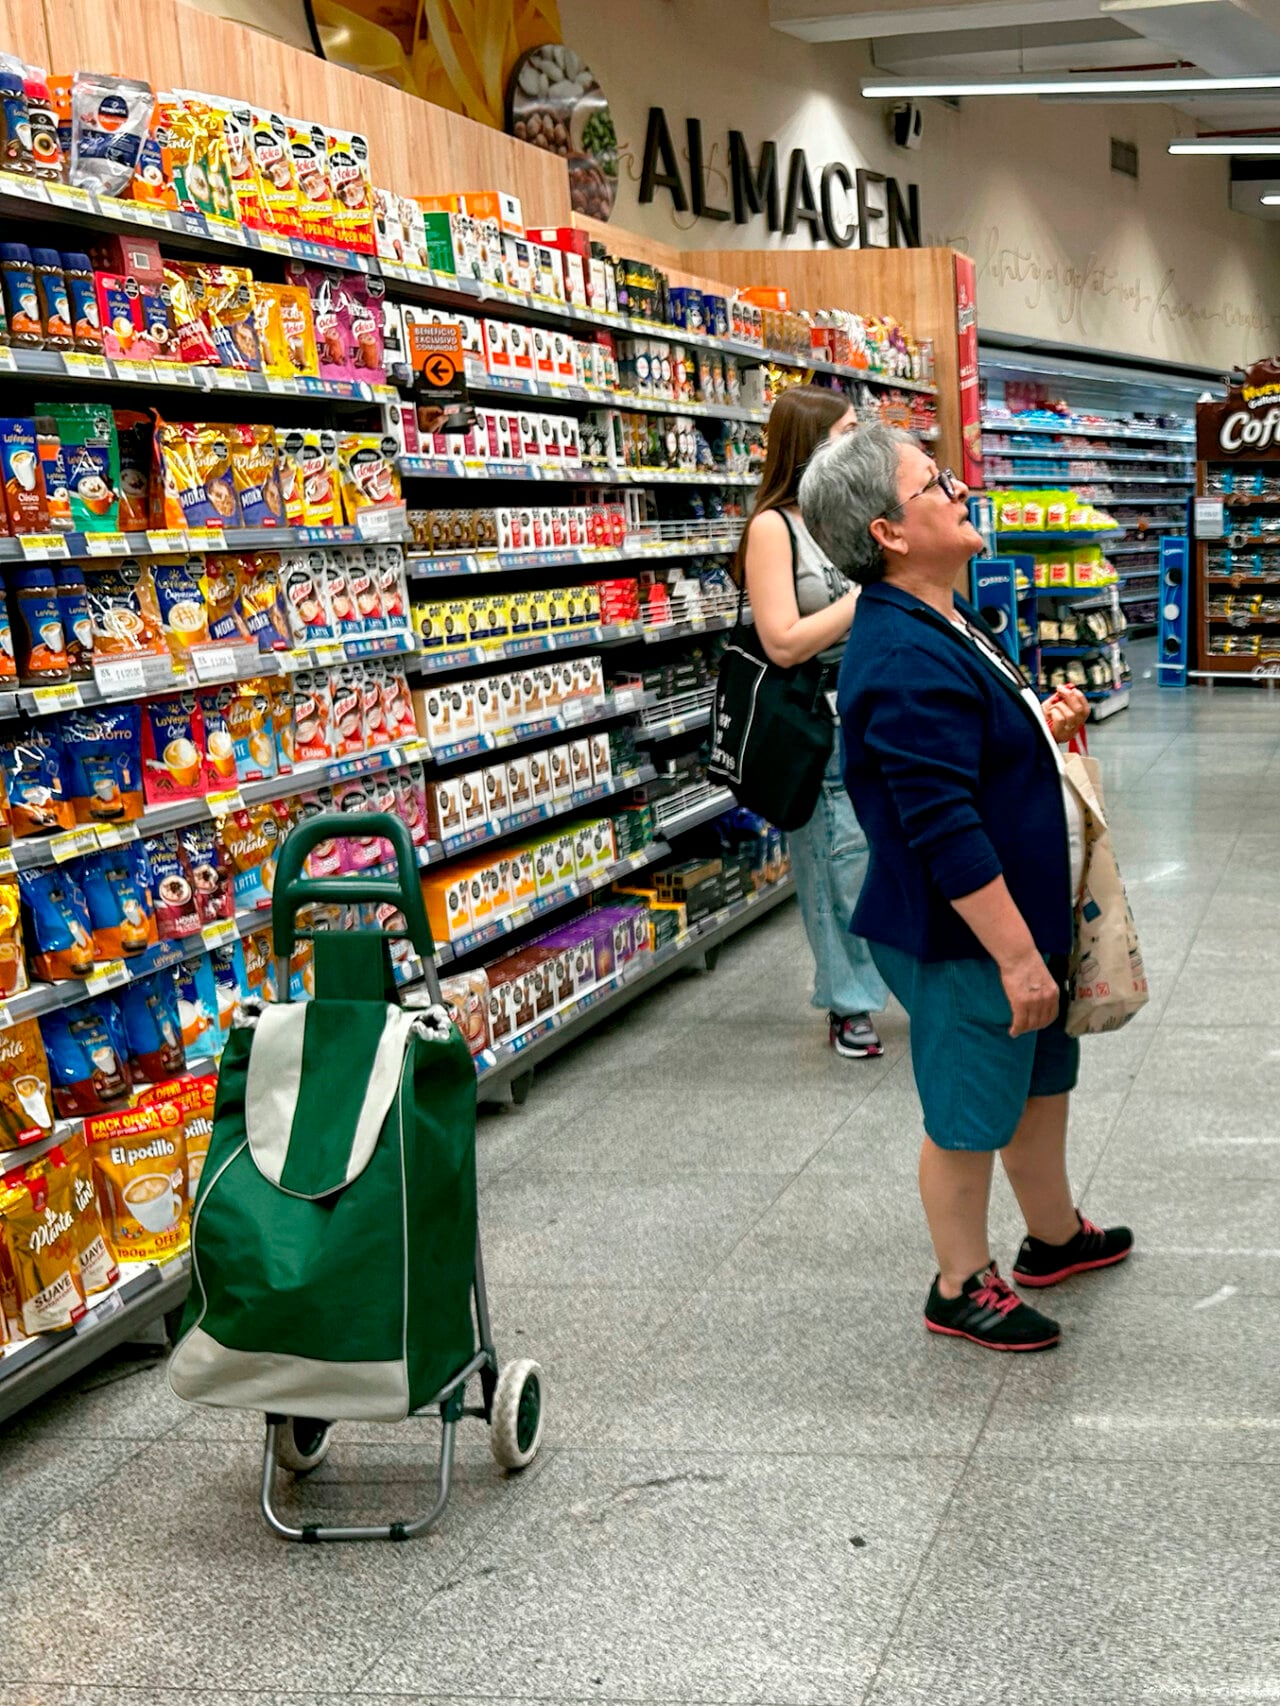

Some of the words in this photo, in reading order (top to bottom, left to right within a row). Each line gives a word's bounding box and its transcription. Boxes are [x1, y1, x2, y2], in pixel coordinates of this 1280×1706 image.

[638, 107, 921, 249] ALMACEN
[414, 328, 457, 337] BENEFICIO
[415, 336, 457, 345] EXCLUSIVO
[91, 1117, 121, 1135] PACK
[111, 1146, 125, 1164] El
[127, 1139, 175, 1165] pocillo
[29, 1210, 74, 1254] Planta
[34, 1274, 72, 1309] SUAVE
